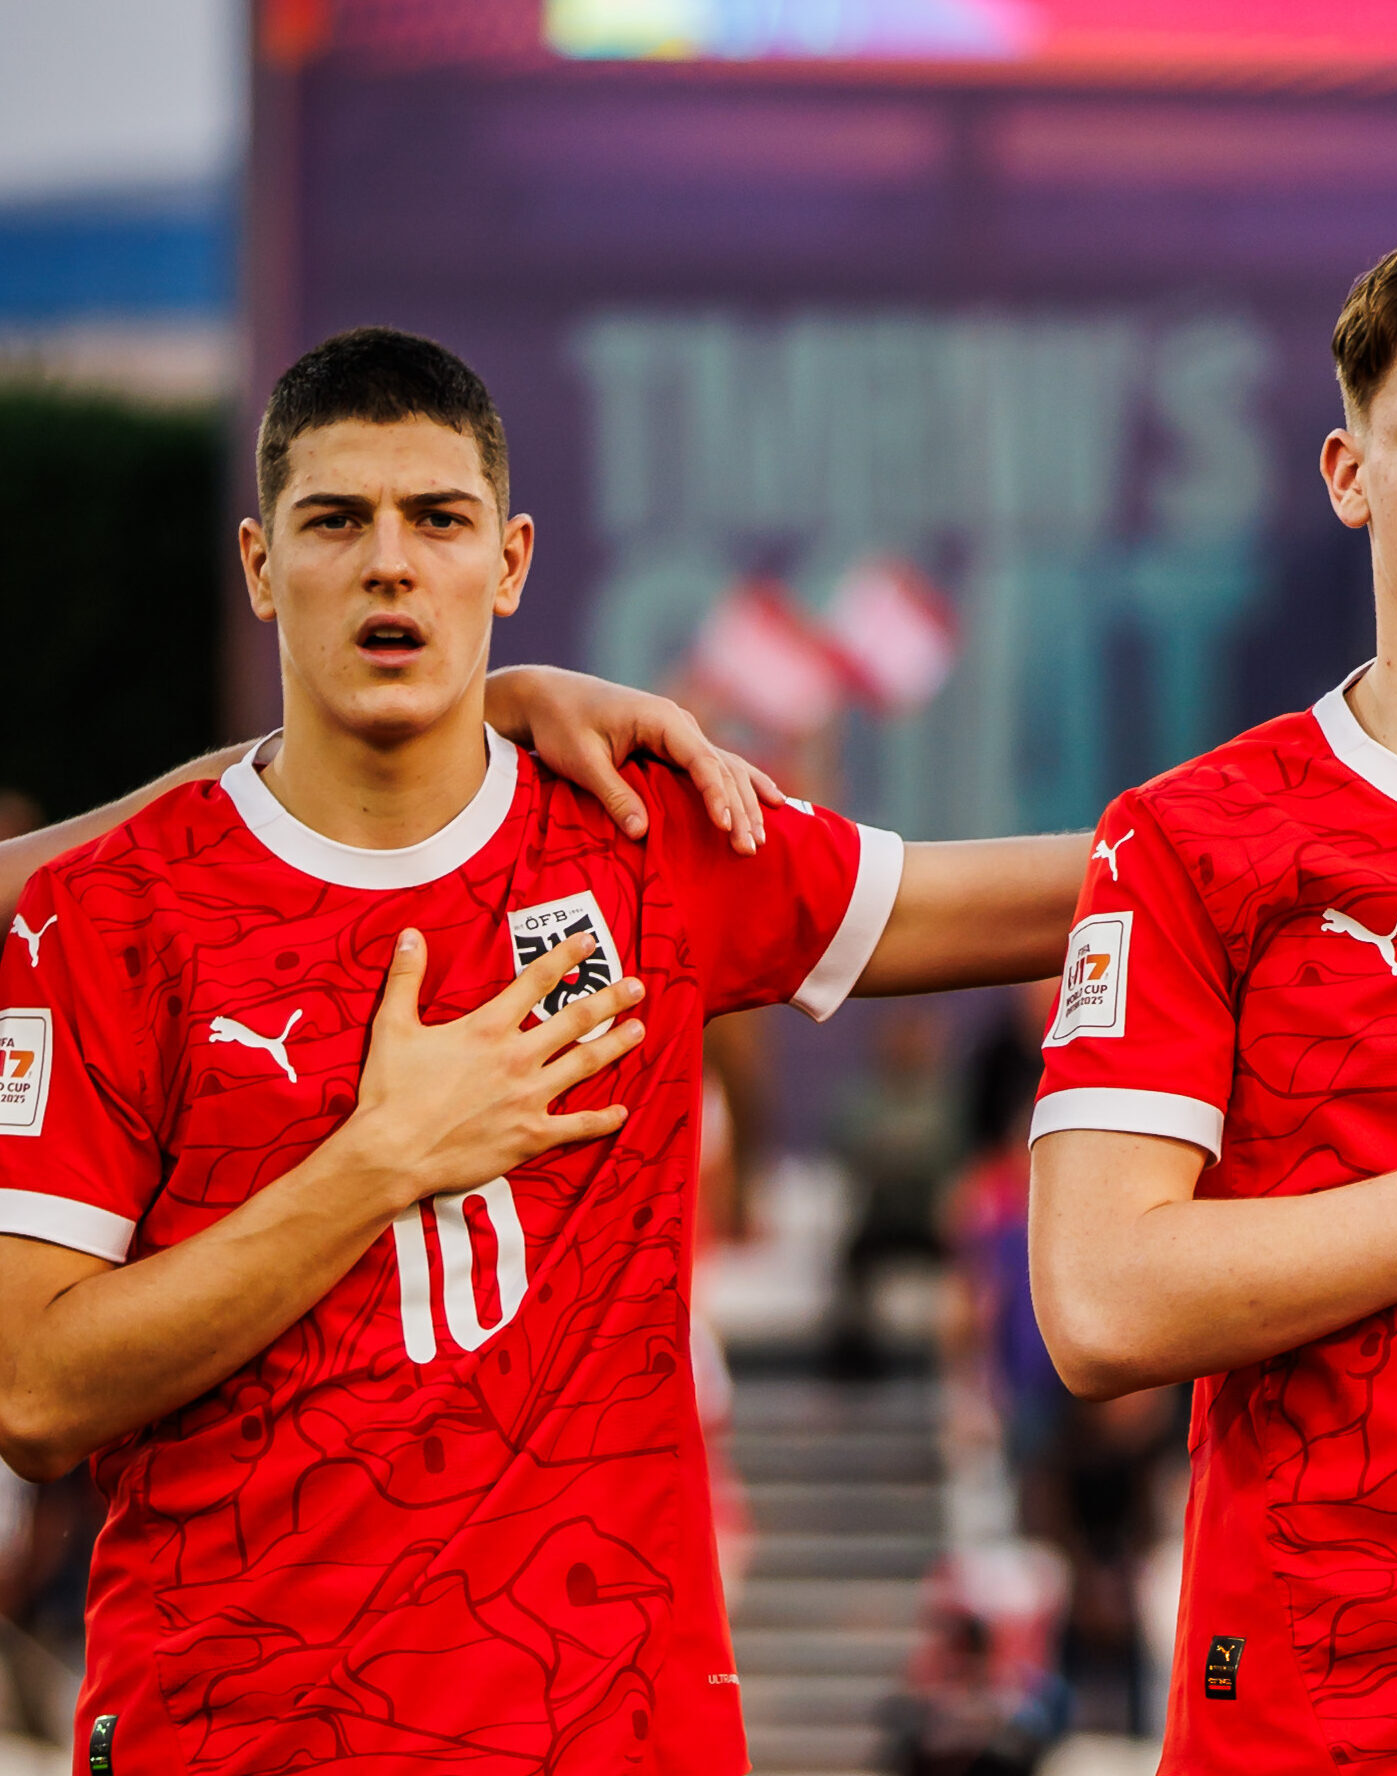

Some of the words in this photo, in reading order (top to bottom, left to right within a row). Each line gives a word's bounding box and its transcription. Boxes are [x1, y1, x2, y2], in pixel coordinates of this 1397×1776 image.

[525, 909, 568, 931] ÖFB
[1084, 984, 1108, 995] CUP
[7, 1082, 31, 1093] CUP
[392, 1174, 530, 1365] 10
